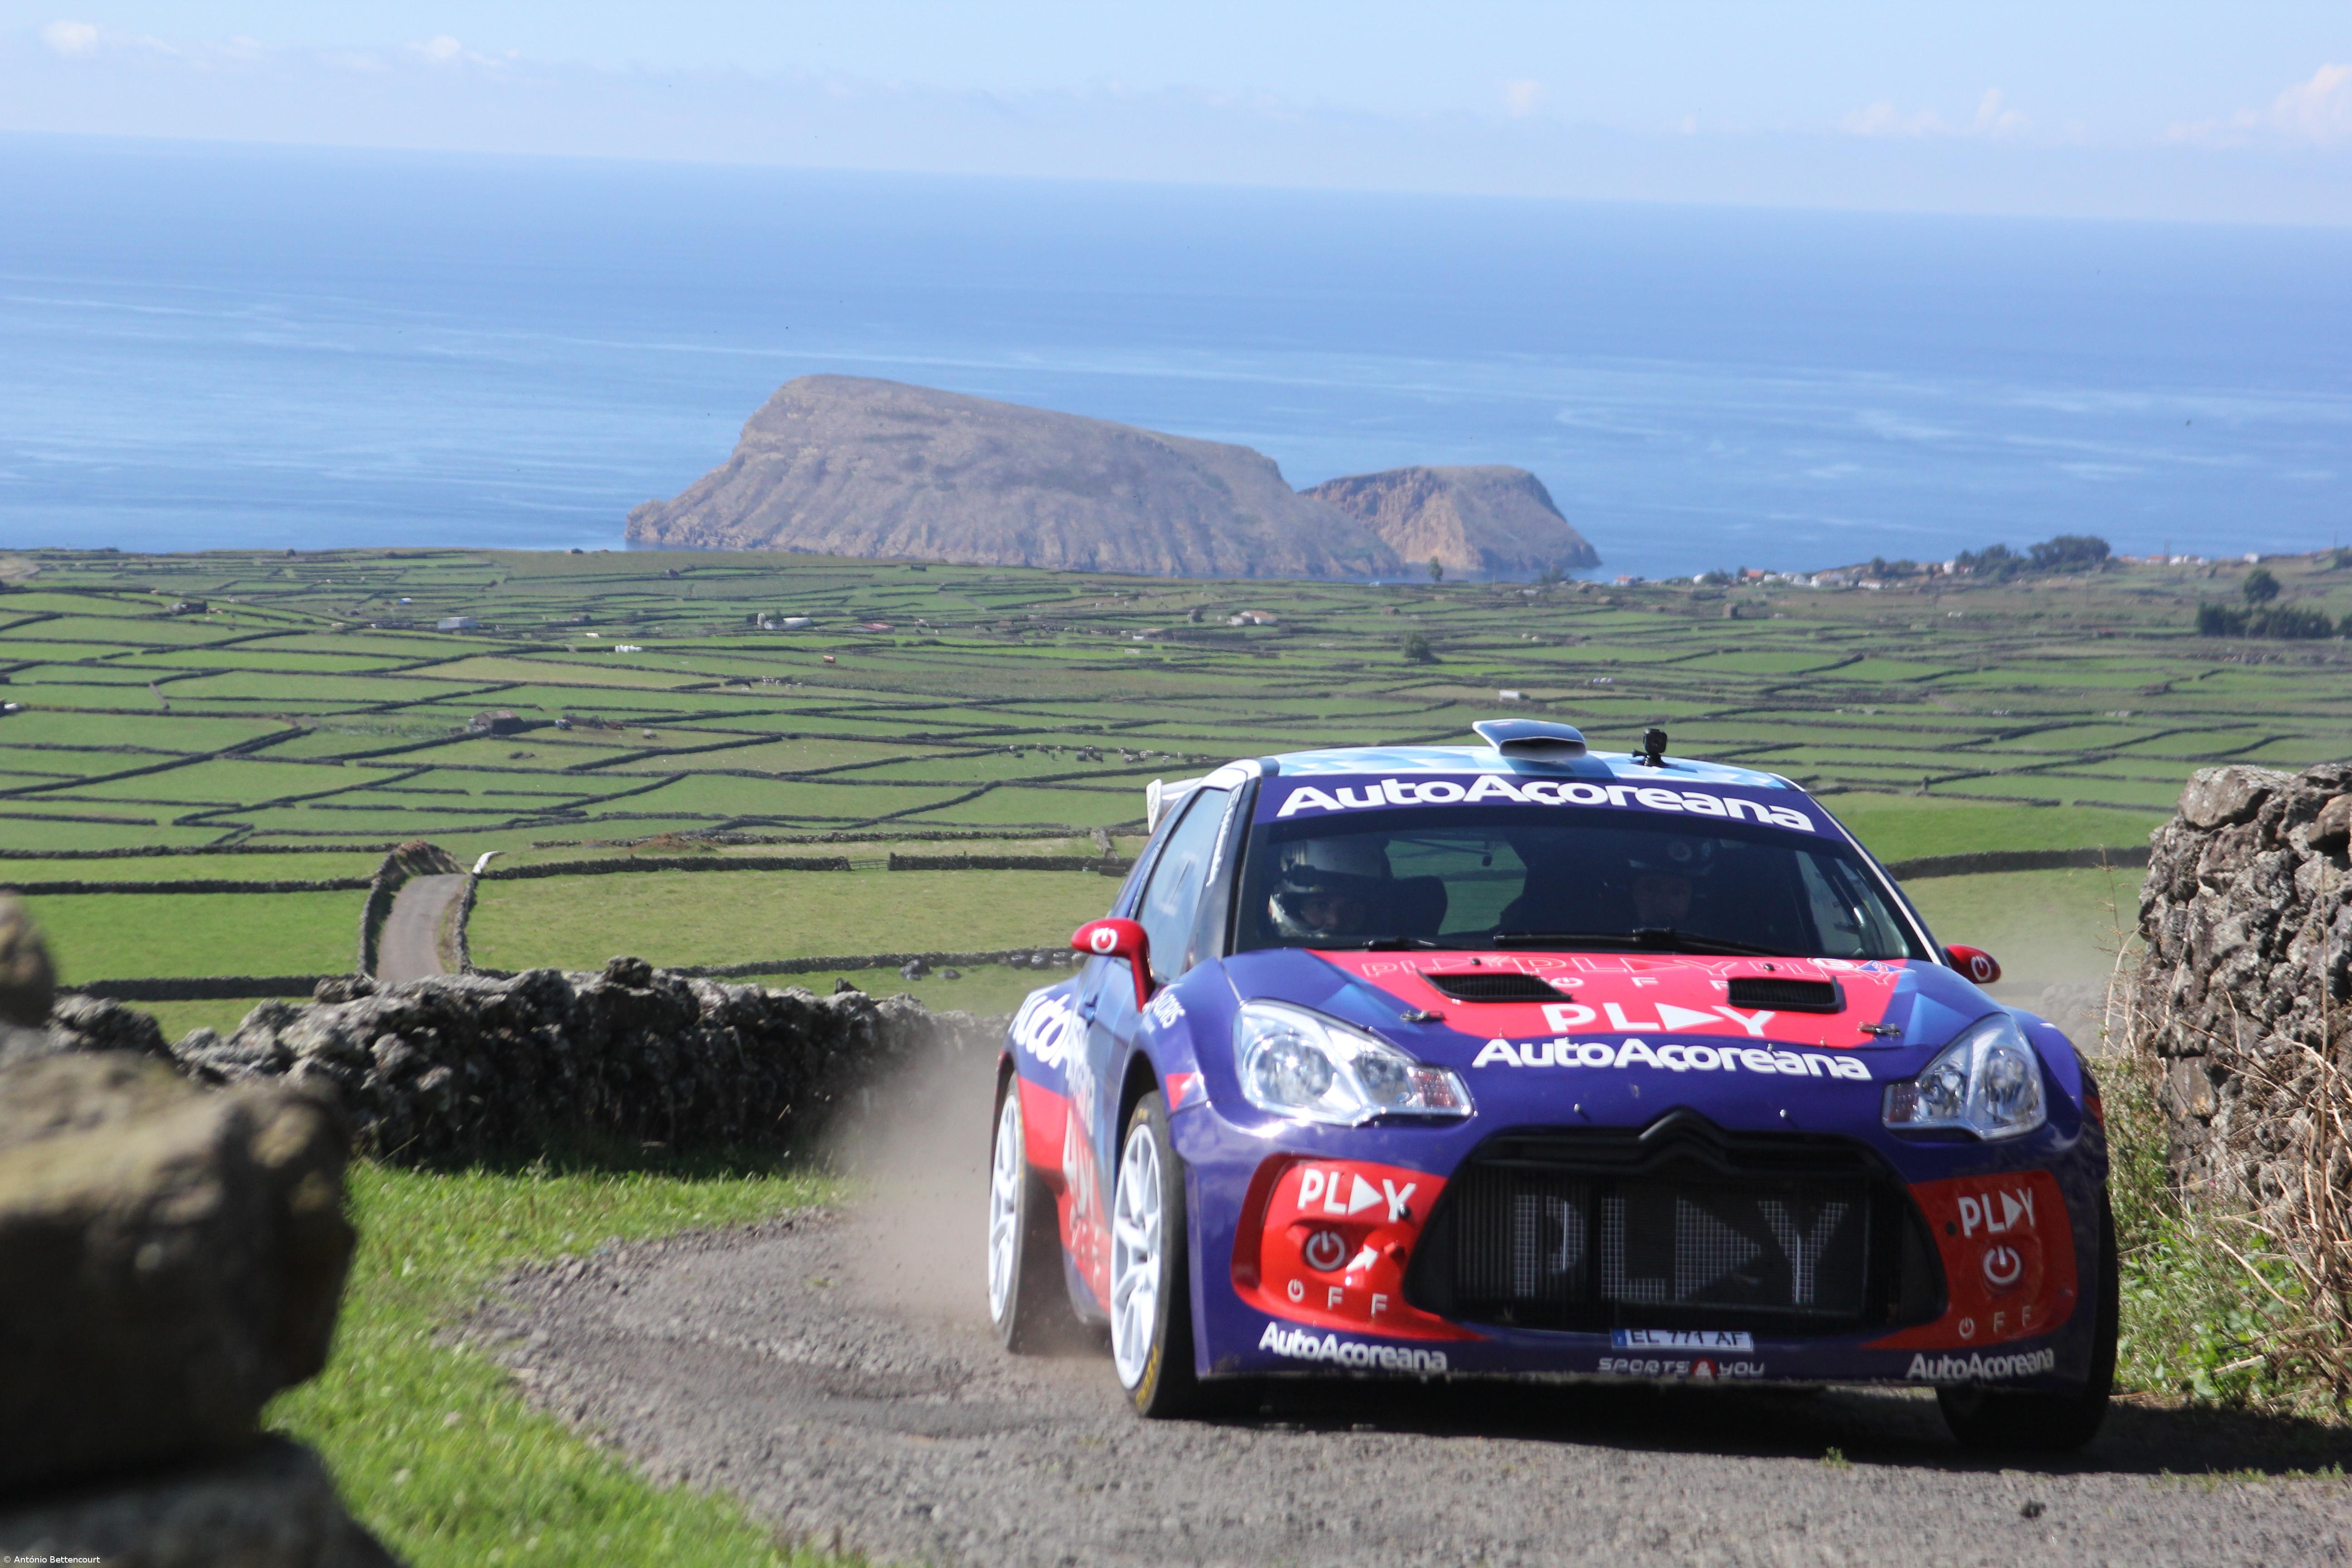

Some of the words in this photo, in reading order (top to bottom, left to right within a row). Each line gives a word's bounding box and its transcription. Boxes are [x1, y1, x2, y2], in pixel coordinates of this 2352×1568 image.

[1277, 775, 1815, 833] AutoAçoreana
[1472, 1038, 1873, 1081] AutoAçoreana
[1259, 1321, 1447, 1372] AutoAçoreana
